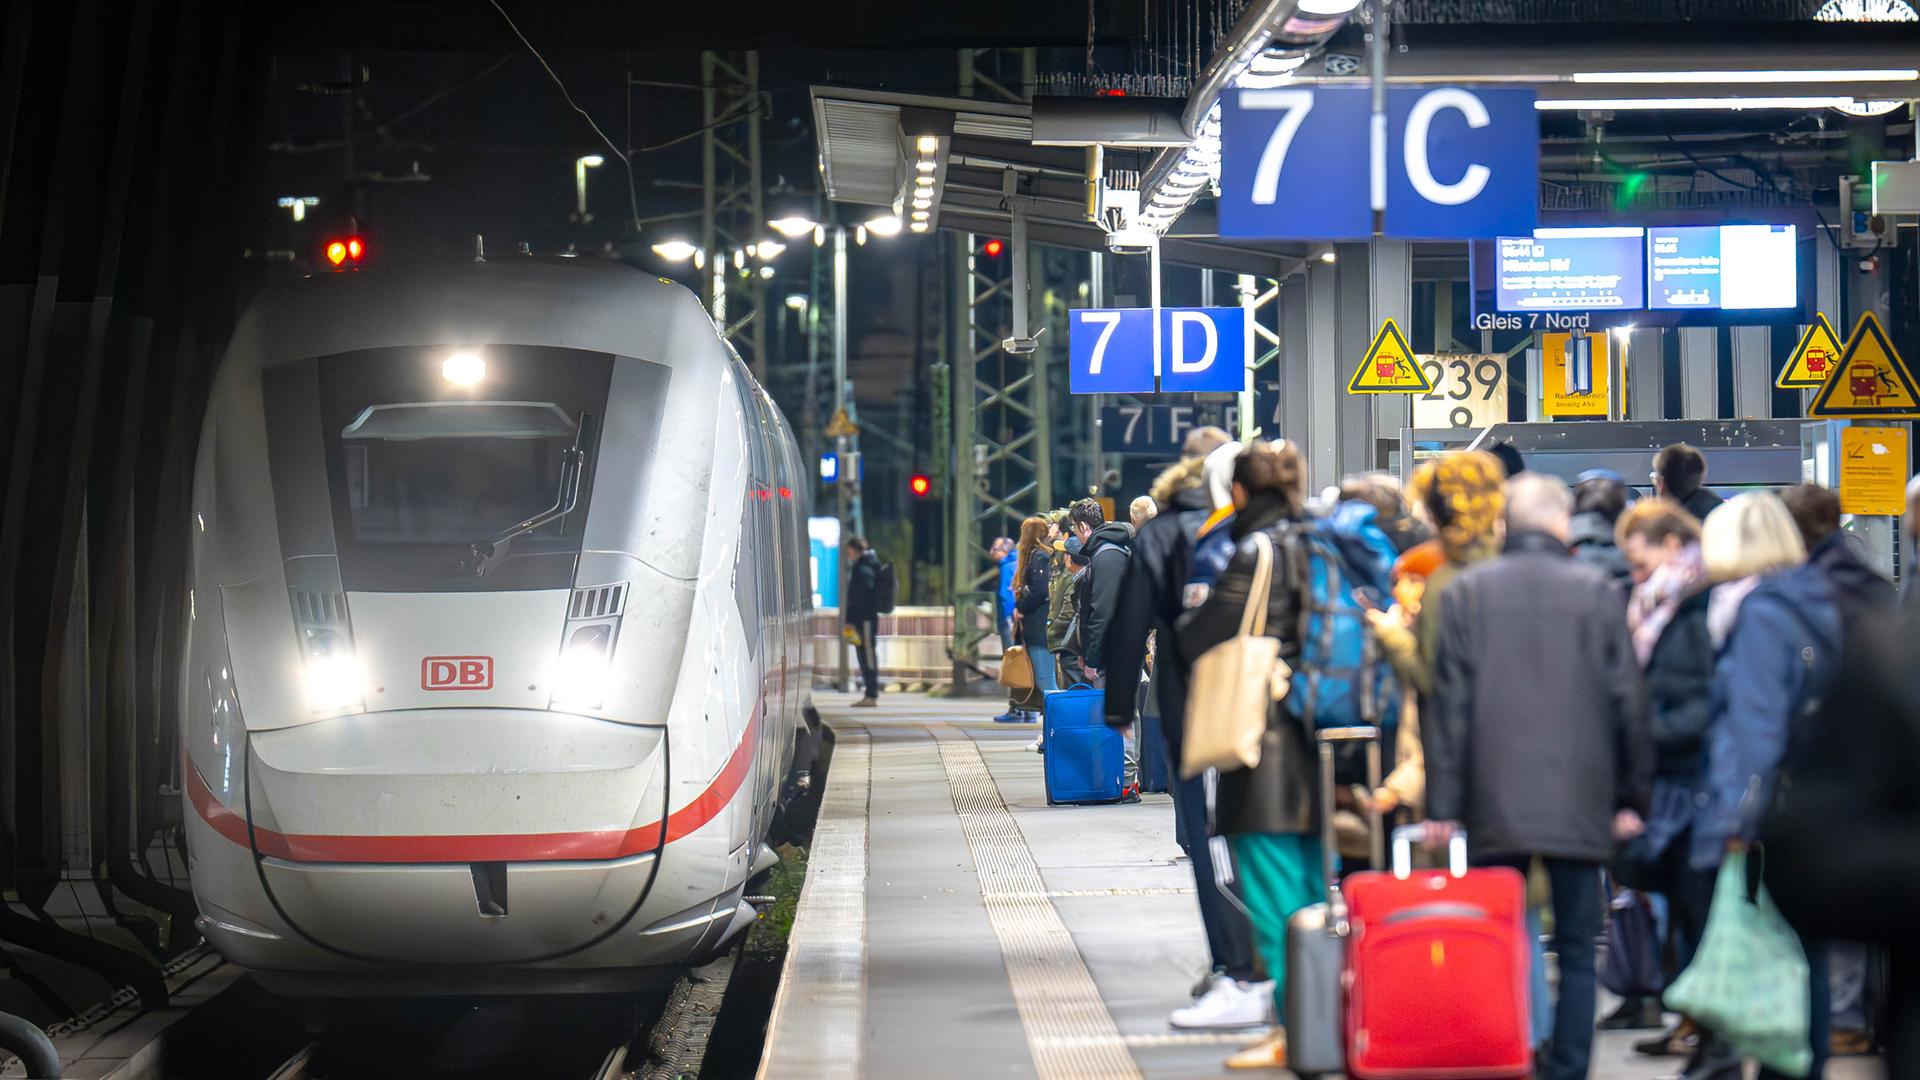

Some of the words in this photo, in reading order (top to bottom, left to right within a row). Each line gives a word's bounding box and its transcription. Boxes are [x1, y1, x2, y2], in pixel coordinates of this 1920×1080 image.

[1238, 89, 1314, 205] 7
[1403, 87, 1491, 206] C
[1476, 313, 1522, 329] Gleis
[1528, 314, 1539, 329] 7
[1546, 312, 1590, 329] Nord
[1081, 312, 1121, 375] 7
[1171, 311, 1218, 373] D
[1420, 359, 1502, 401] 239
[1119, 406, 1143, 444] 7
[1171, 406, 1193, 444] F
[430, 661, 485, 685] DB
